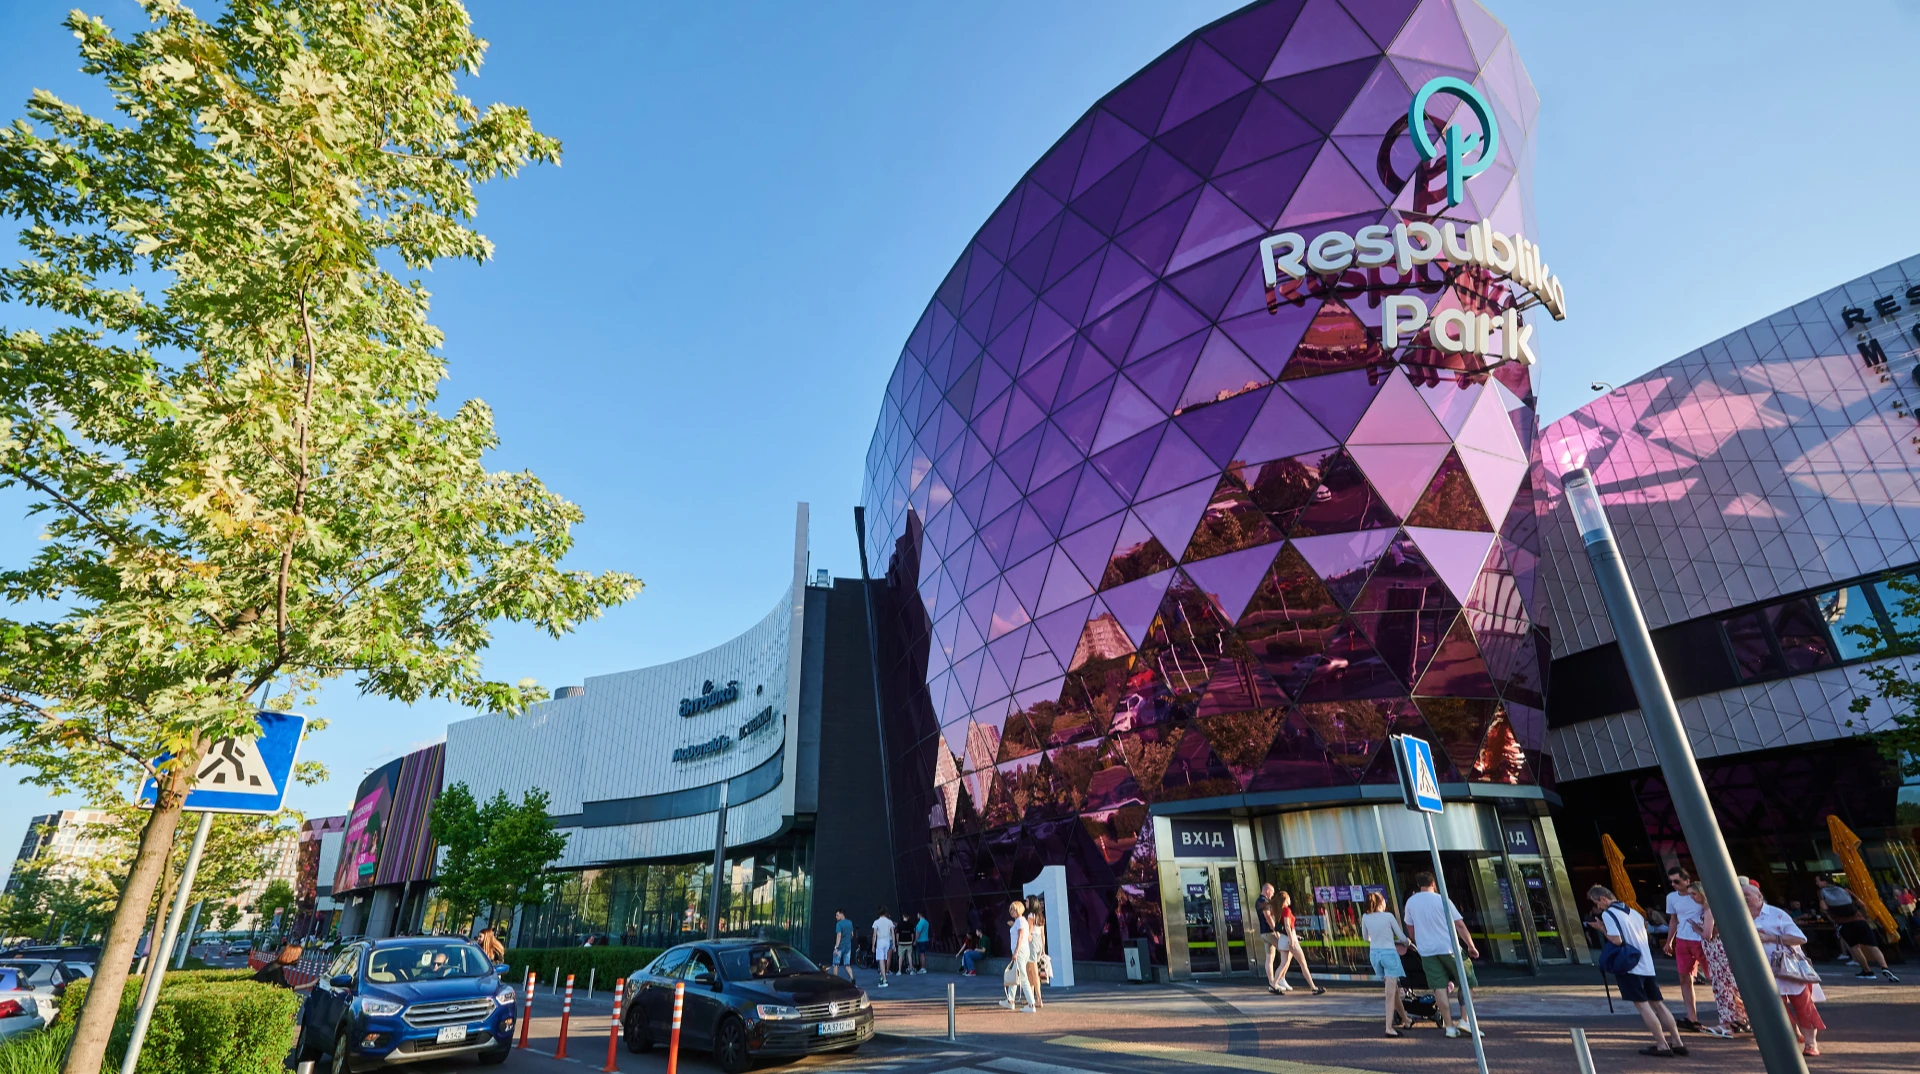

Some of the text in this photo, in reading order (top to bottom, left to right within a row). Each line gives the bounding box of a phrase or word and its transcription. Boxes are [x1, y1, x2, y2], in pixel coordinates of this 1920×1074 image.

[1260, 218, 1567, 321] Respublika
[1382, 295, 1536, 366] Park
[672, 735, 730, 763] McDonald's
[1181, 832, 1225, 848] ВХІД
[1507, 831, 1528, 846] ІД
[1022, 865, 1075, 987] 1
[823, 1024, 831, 1032] KA
